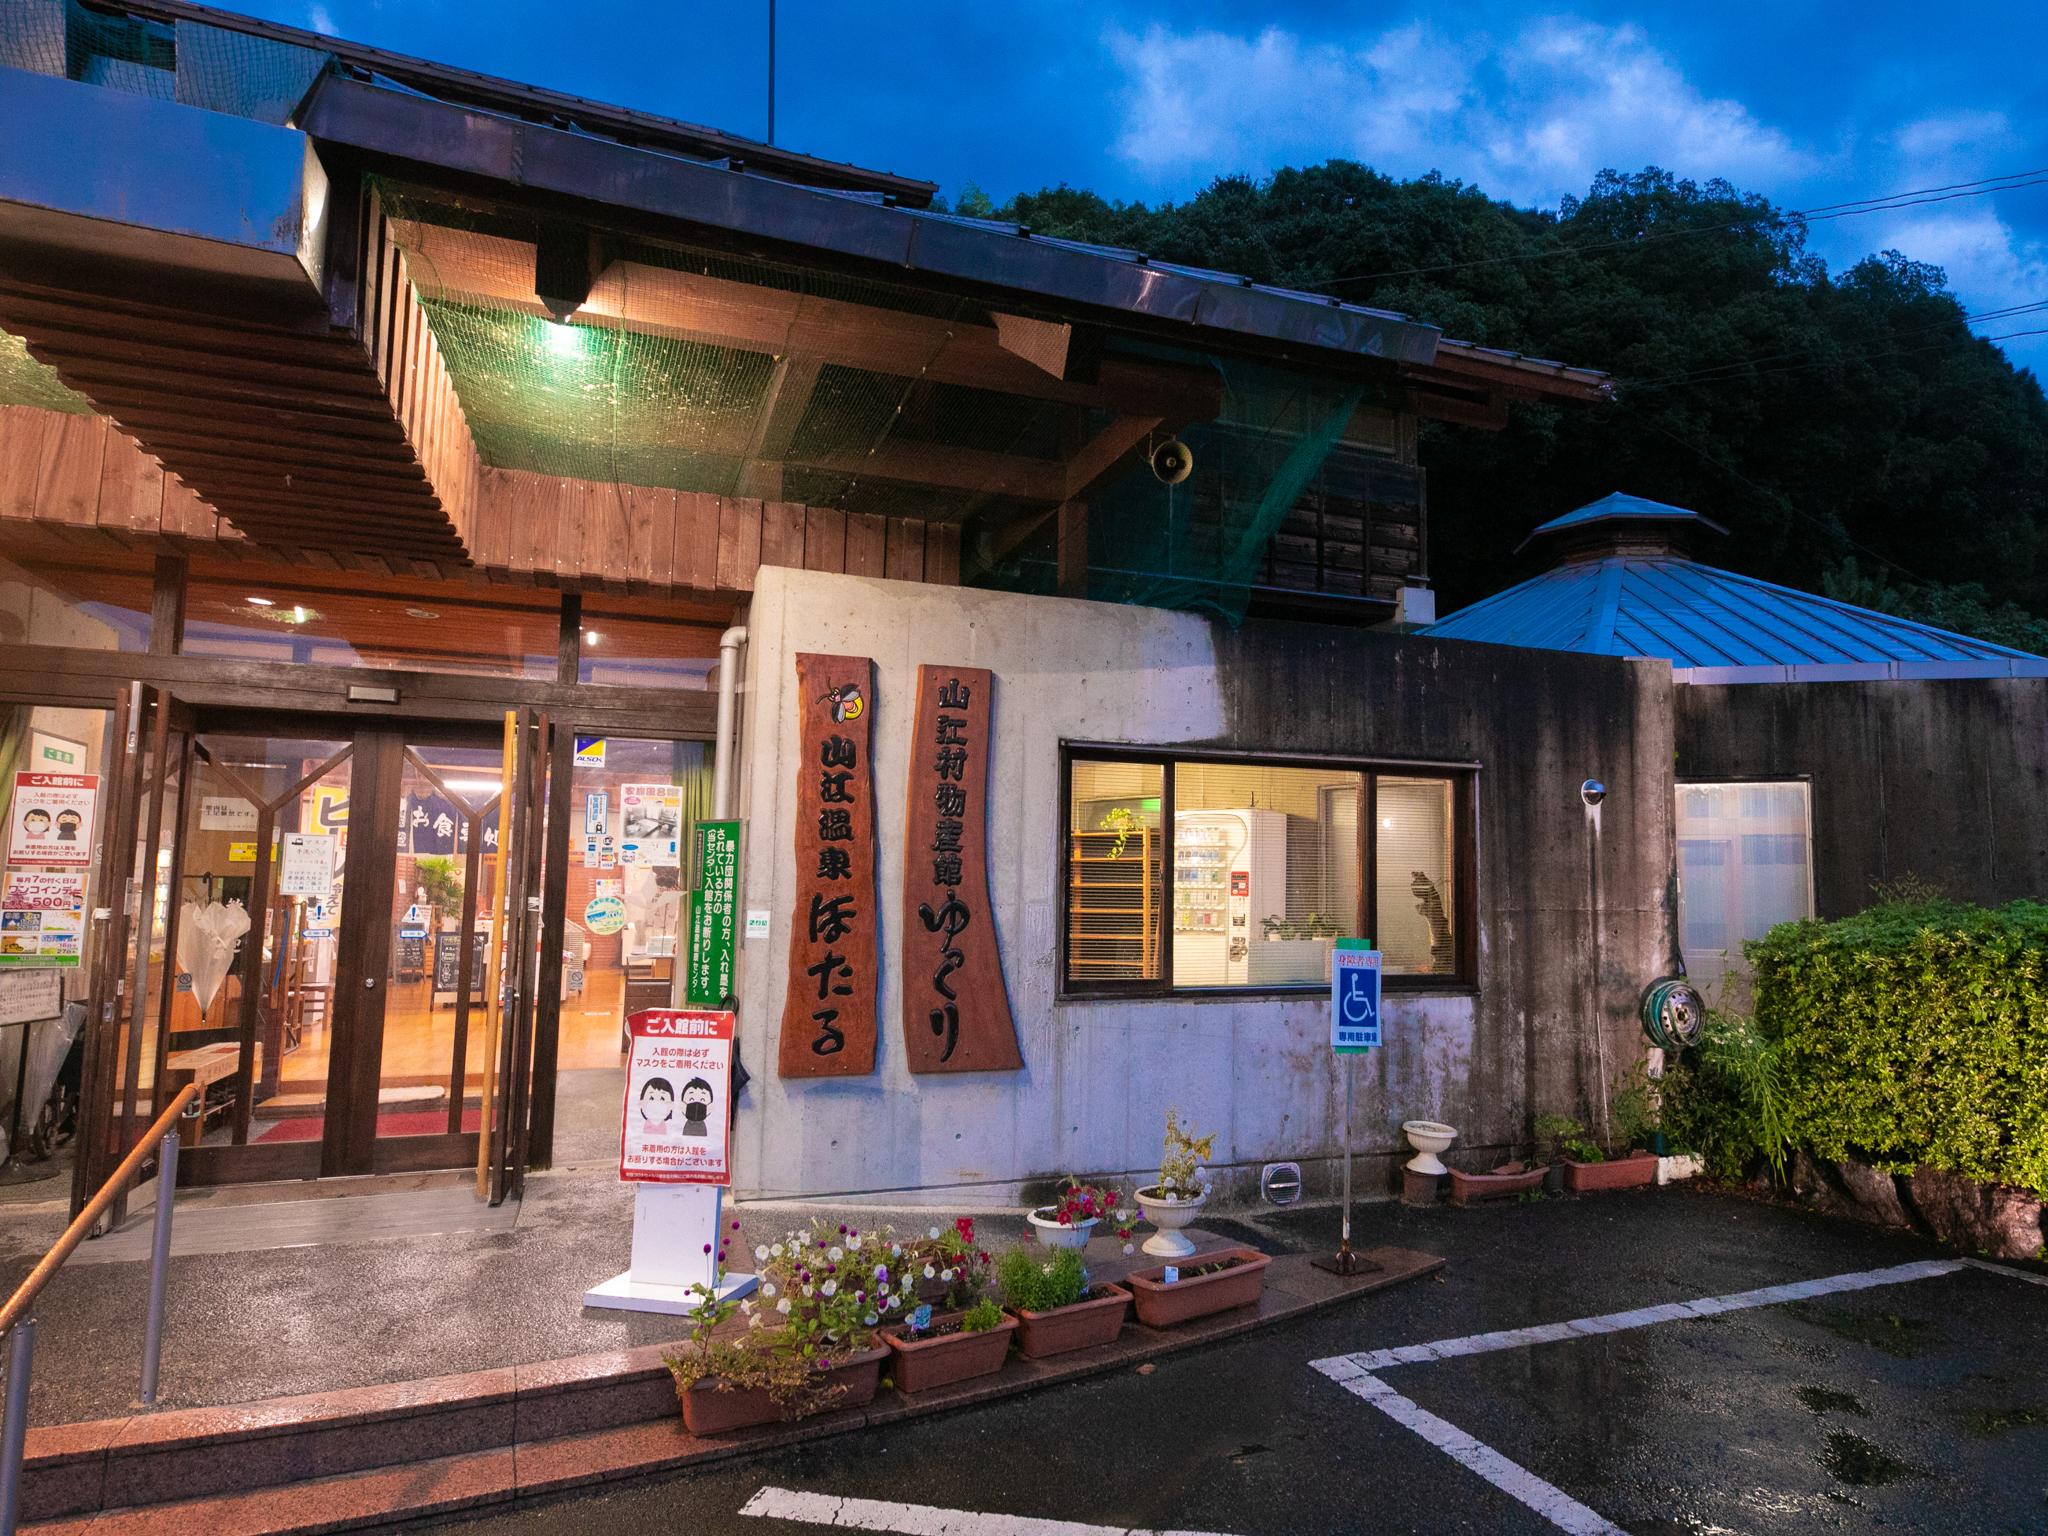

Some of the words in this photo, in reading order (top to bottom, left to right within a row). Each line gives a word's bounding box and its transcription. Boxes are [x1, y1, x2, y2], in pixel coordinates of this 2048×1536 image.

[31, 775, 84, 787] ご入館前に
[713, 828, 726, 914] されている方の
[918, 678, 971, 1064] 山江村物産館ゆっくり
[806, 733, 859, 1057] 山江温泉ほたる
[32, 897, 71, 907] 500円
[646, 1017, 718, 1035] ご入館前に
[652, 1047, 709, 1057] 入館の際は必ず
[636, 1058, 724, 1070] マスクをご着用ください
[641, 1144, 706, 1155] 未着用の方は入館を
[627, 1155, 723, 1167] お断りする場合がございます
